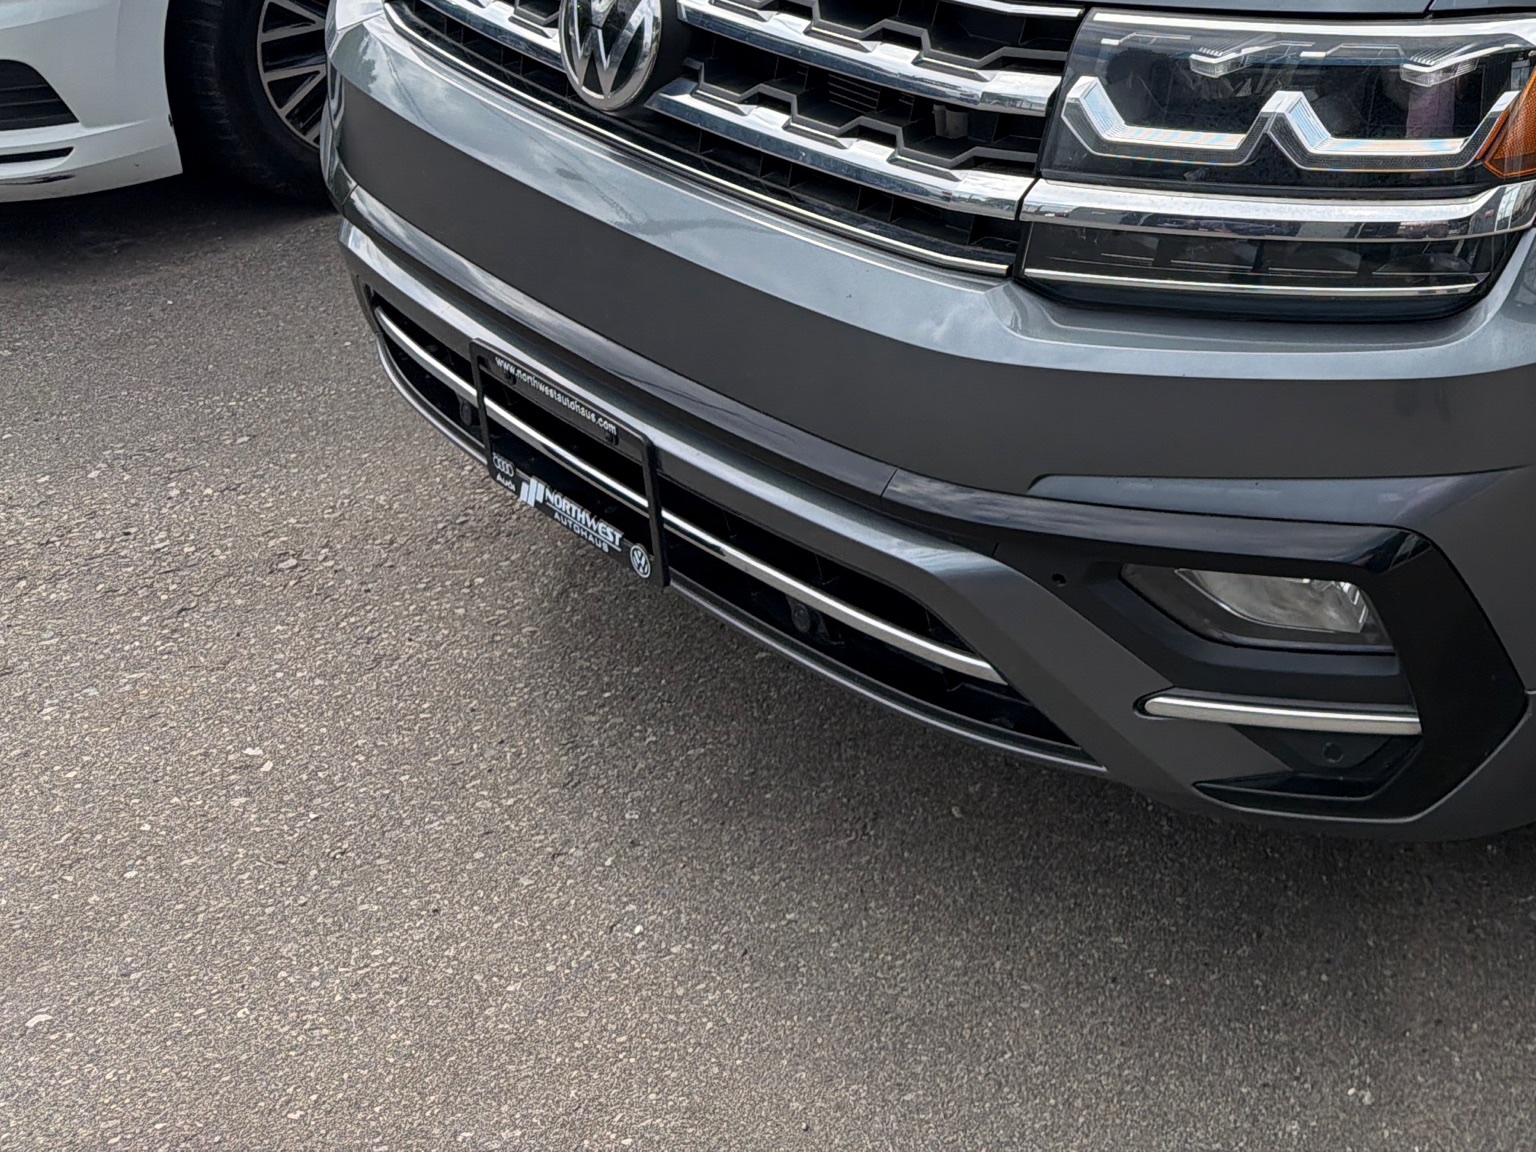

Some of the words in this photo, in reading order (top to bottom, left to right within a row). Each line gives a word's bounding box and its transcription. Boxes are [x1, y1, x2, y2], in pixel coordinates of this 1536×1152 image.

[495, 356, 617, 436] www.northwestautohaus.com
[496, 473, 516, 492] Audi
[544, 487, 624, 546] NORTHWEST
[554, 512, 609, 553] AUTOHAUS
